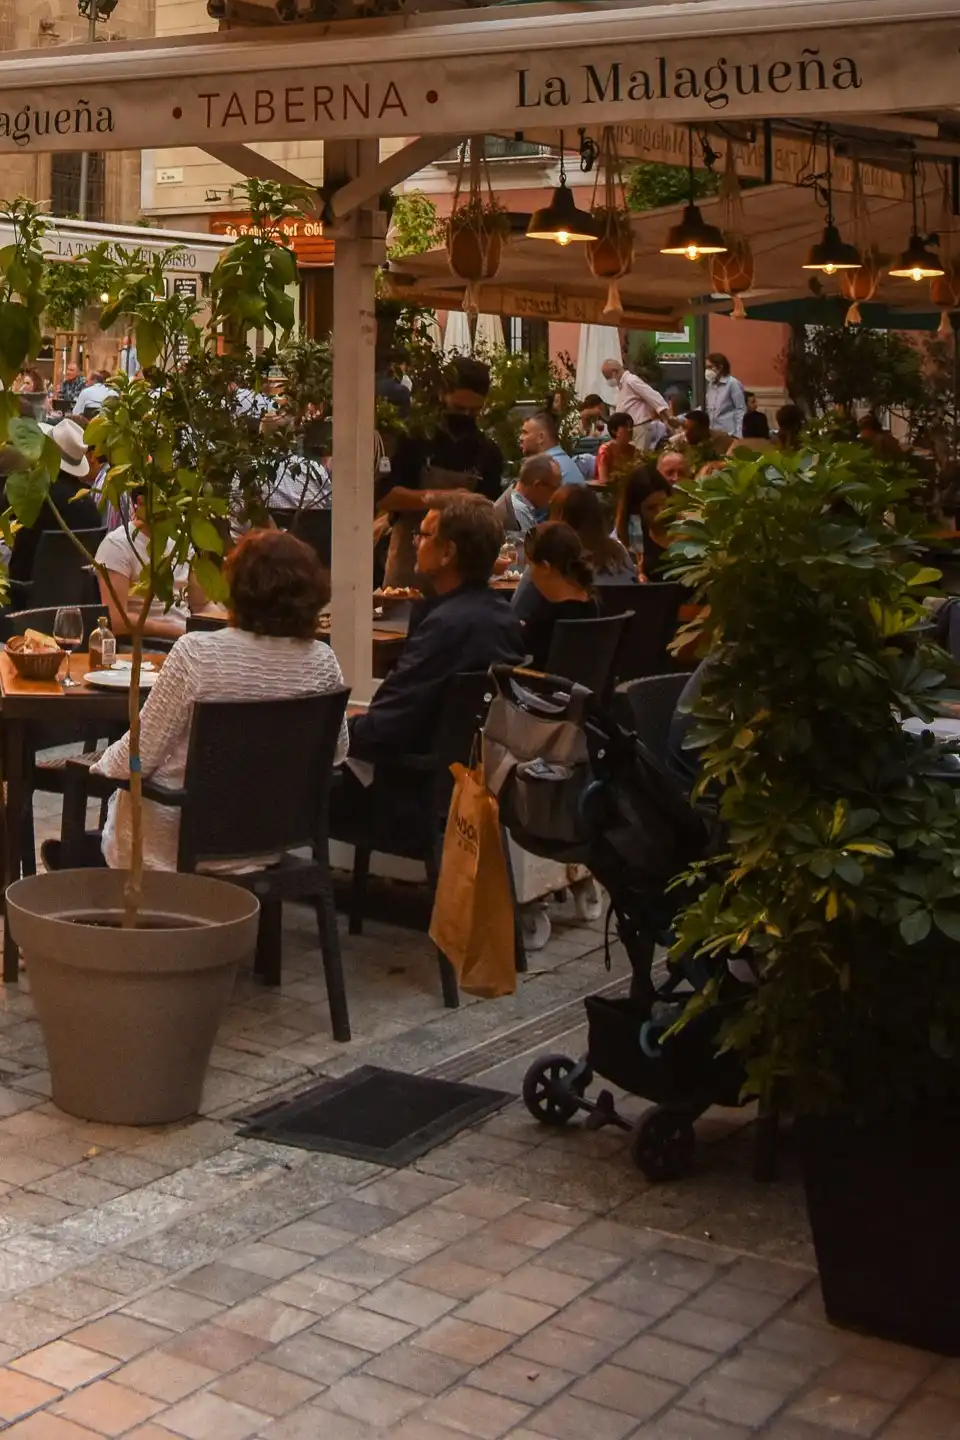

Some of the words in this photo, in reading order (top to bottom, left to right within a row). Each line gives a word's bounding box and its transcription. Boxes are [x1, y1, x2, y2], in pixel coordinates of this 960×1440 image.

[197, 80, 409, 129] TABERNA
[515, 68, 571, 108] La
[581, 48, 863, 110] Malagueña
[303, 222, 324, 237] Obi
[58, 241, 74, 257] LA
